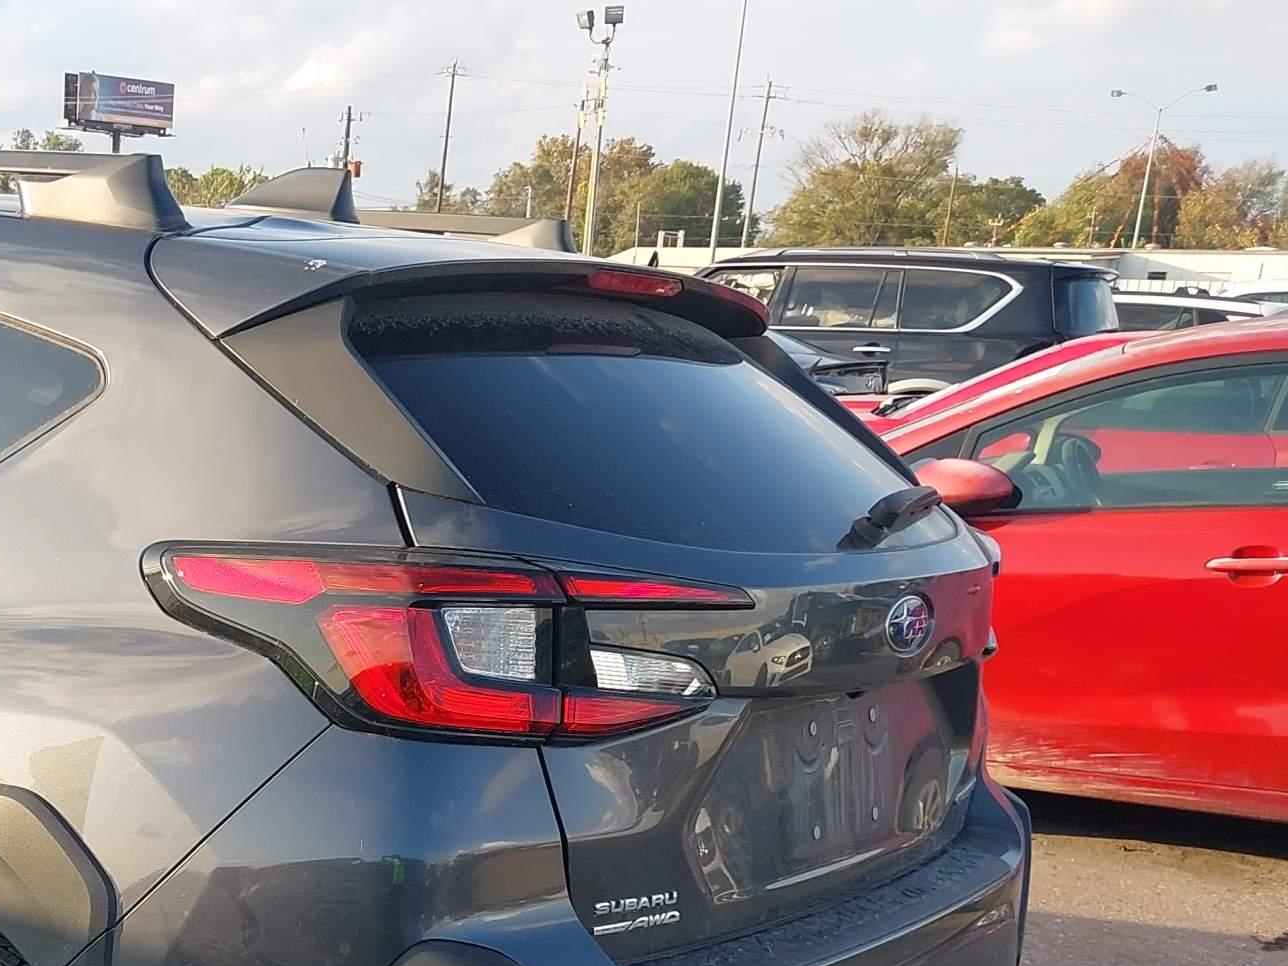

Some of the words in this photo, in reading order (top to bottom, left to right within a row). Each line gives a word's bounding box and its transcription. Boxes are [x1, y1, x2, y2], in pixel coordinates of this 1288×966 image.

[126, 83, 156, 96] centrum
[593, 890, 679, 917] SUBARU
[627, 909, 681, 931] AWD
